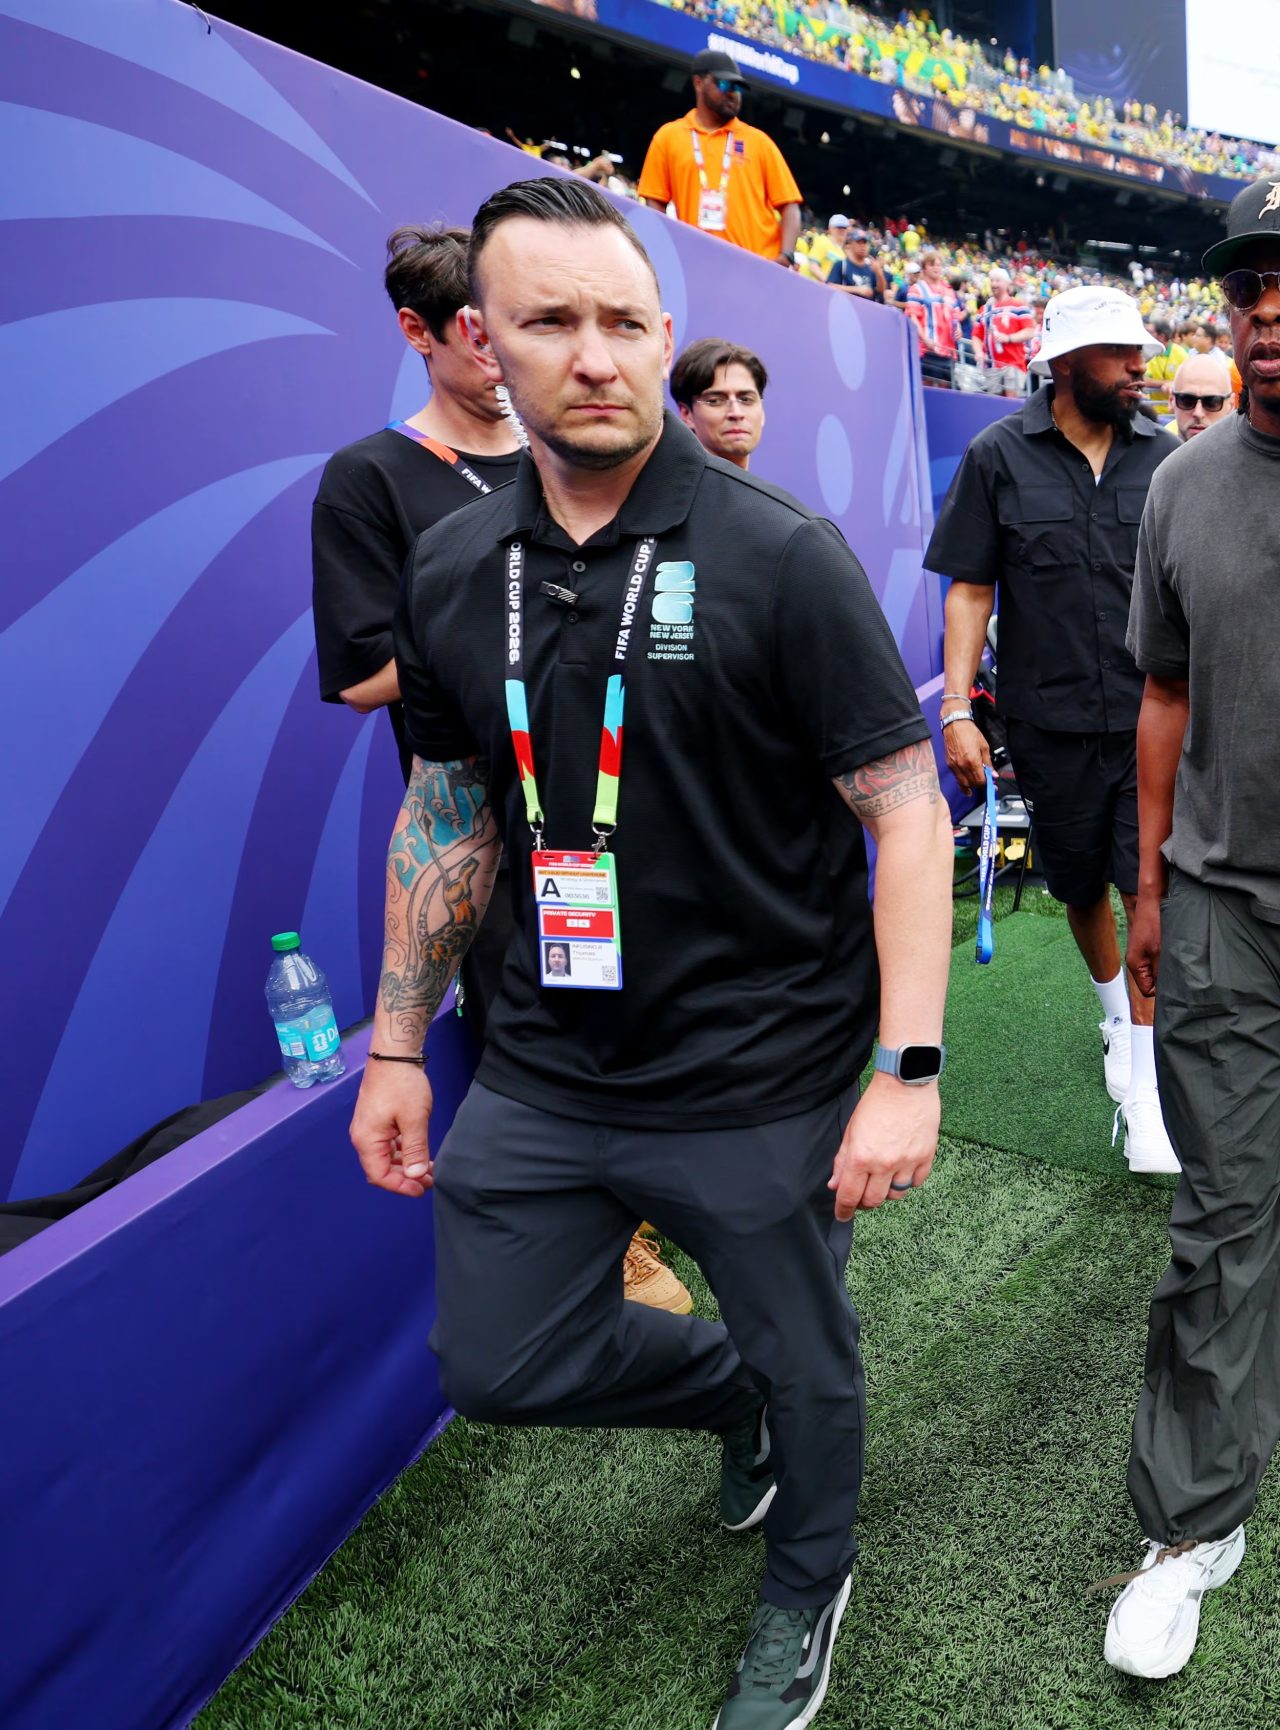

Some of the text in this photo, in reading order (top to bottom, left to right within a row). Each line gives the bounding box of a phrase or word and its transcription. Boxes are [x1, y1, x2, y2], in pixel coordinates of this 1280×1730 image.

[461, 467, 482, 488] FIFA
[634, 544, 651, 573] CUP
[508, 580, 521, 610] CUP
[620, 574, 643, 626] WORLD
[508, 611, 521, 663] 2026
[649, 631, 694, 640] NEW JERSEY
[650, 624, 694, 633] NEW YORK
[615, 628, 631, 660] FIFA
[655, 643, 688, 651] DIVISION
[647, 651, 695, 660] SUPERVISOR
[540, 878, 561, 898] A
